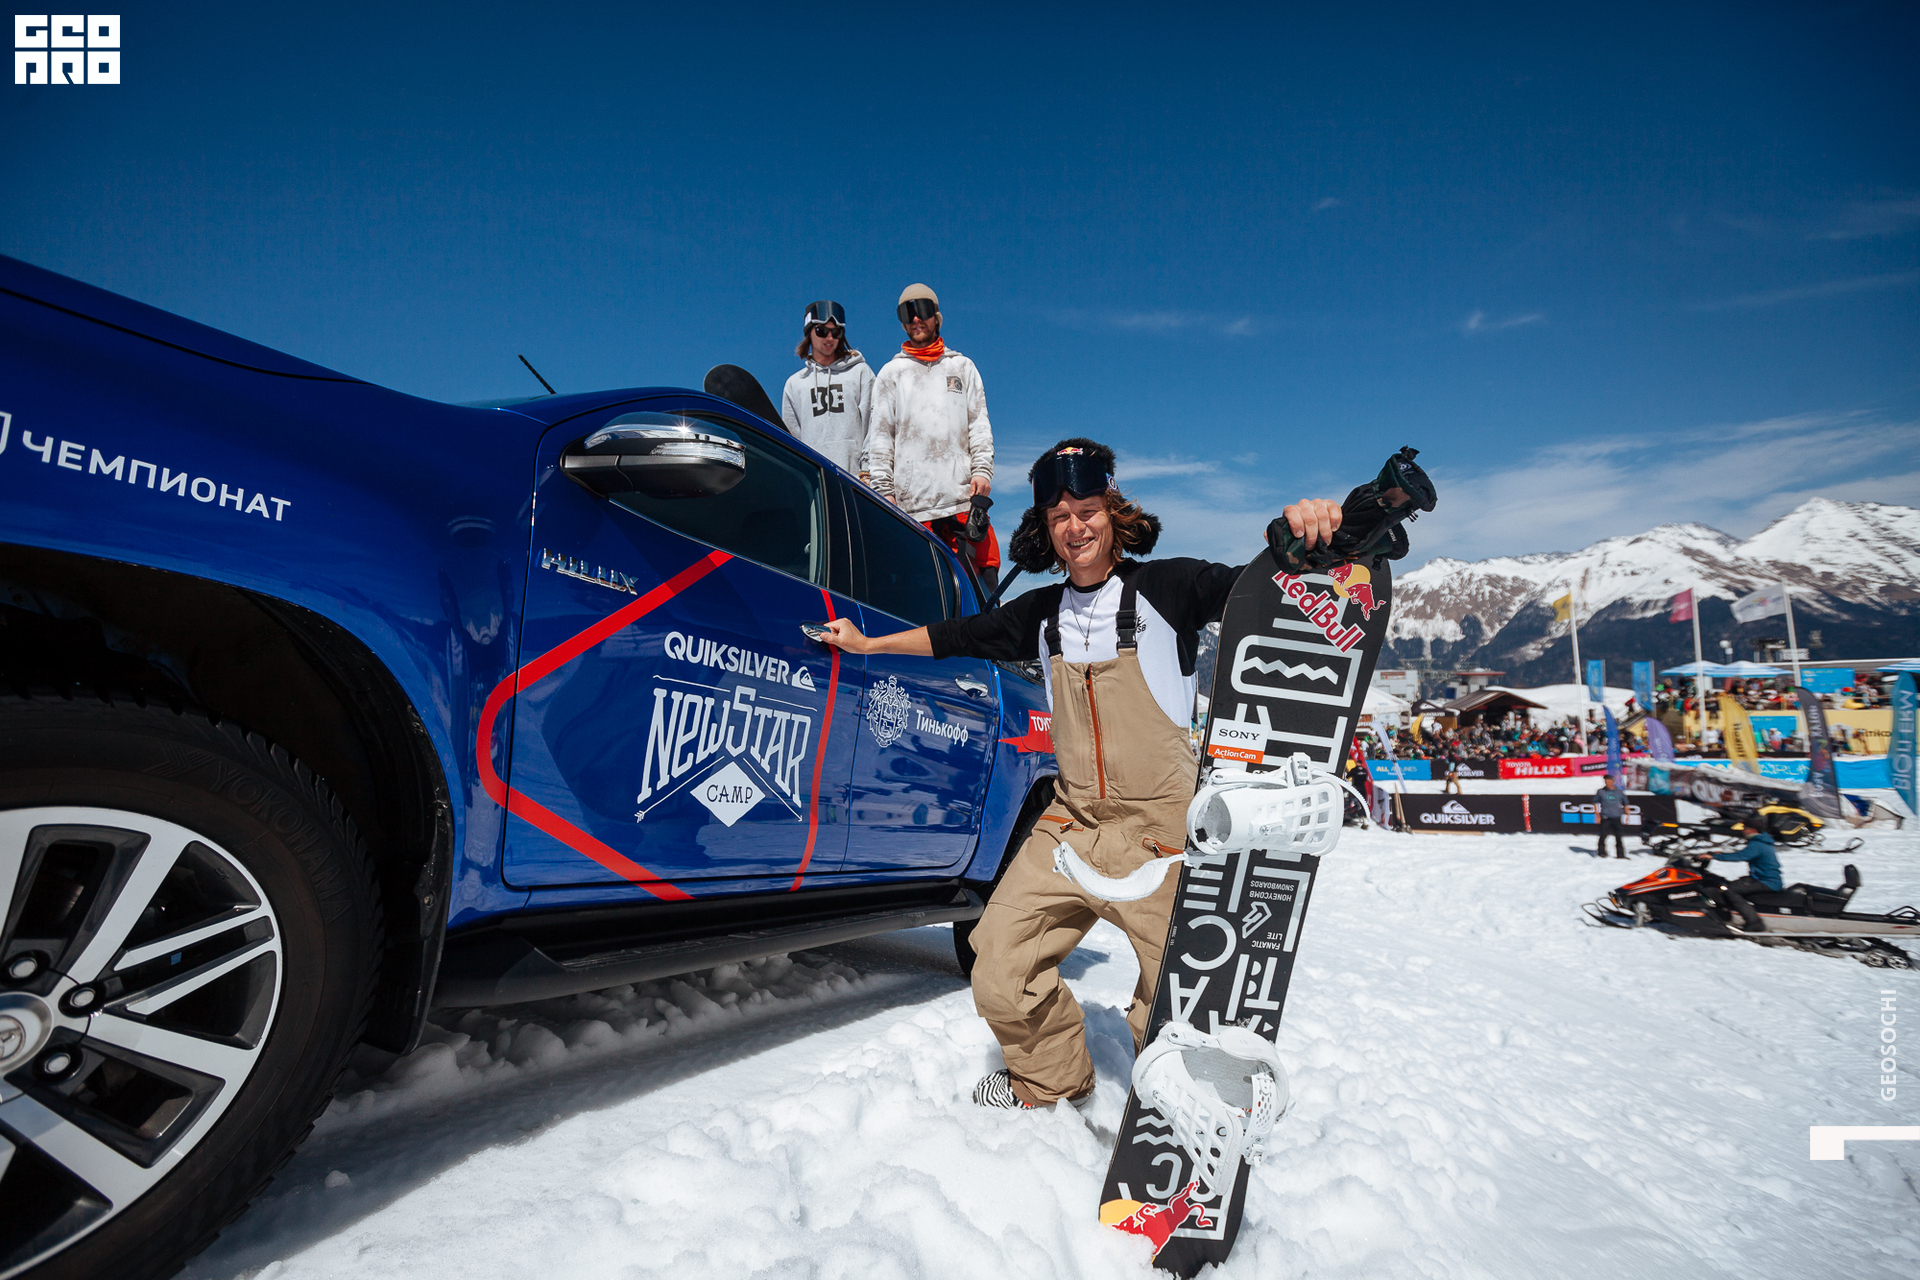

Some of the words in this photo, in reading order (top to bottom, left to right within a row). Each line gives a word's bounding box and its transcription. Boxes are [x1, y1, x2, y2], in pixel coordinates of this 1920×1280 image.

[810, 384, 844, 417] DC
[22, 430, 291, 521] ЧЕМПИОНАТ
[541, 548, 639, 595] HILUX
[664, 631, 789, 685] QUIKSILVER
[915, 709, 969, 746] Тинькофф
[1219, 728, 1260, 741] SONY
[1515, 765, 1567, 776] HILUX
[706, 784, 754, 805] CAMP
[1420, 812, 1495, 825] QUIKSILVER
[210, 760, 352, 926] YOKOHAMA
[1250, 880, 1294, 892] SNOWBOARDS
[1249, 890, 1292, 902] HONEYCOMB
[1267, 931, 1283, 941] LITE
[1251, 940, 1281, 950] FANATIC
